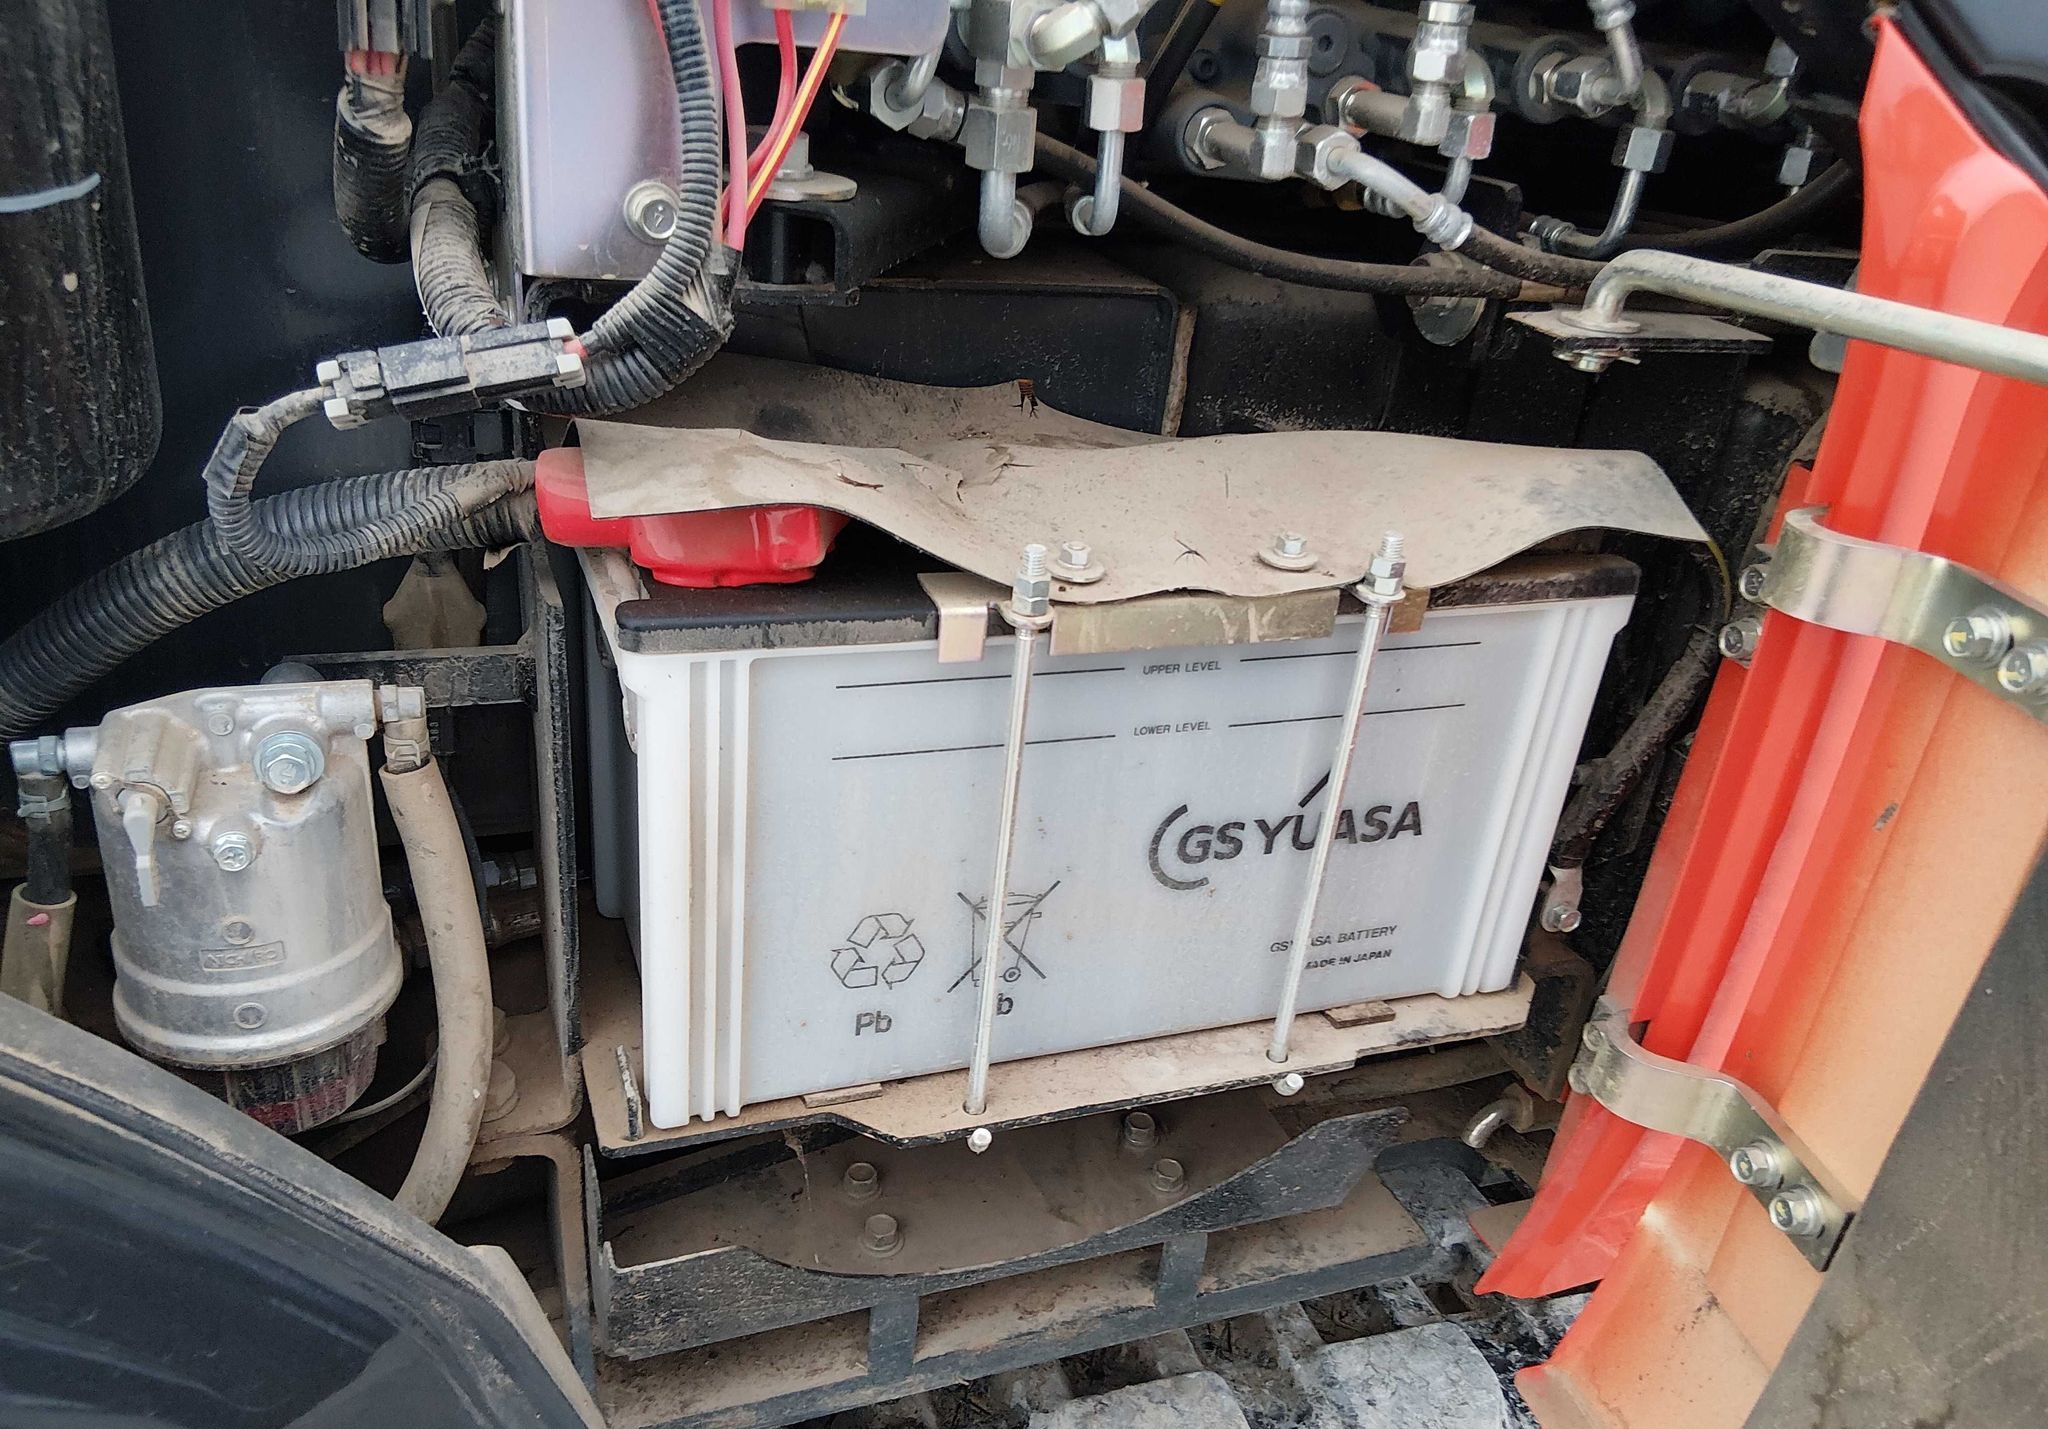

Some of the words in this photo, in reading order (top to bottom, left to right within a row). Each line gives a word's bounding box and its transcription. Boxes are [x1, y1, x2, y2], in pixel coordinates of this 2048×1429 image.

[1142, 663, 1180, 675] UPPER
[1185, 660, 1222, 673] LEVEL
[1133, 724, 1171, 736] LOWER
[1175, 721, 1211, 733] LEVEL
[1337, 925, 1397, 943] BATTERY
[1338, 955, 1352, 965] IN
[1353, 949, 1392, 962] JAPAN
[855, 1010, 892, 1036] Pb
